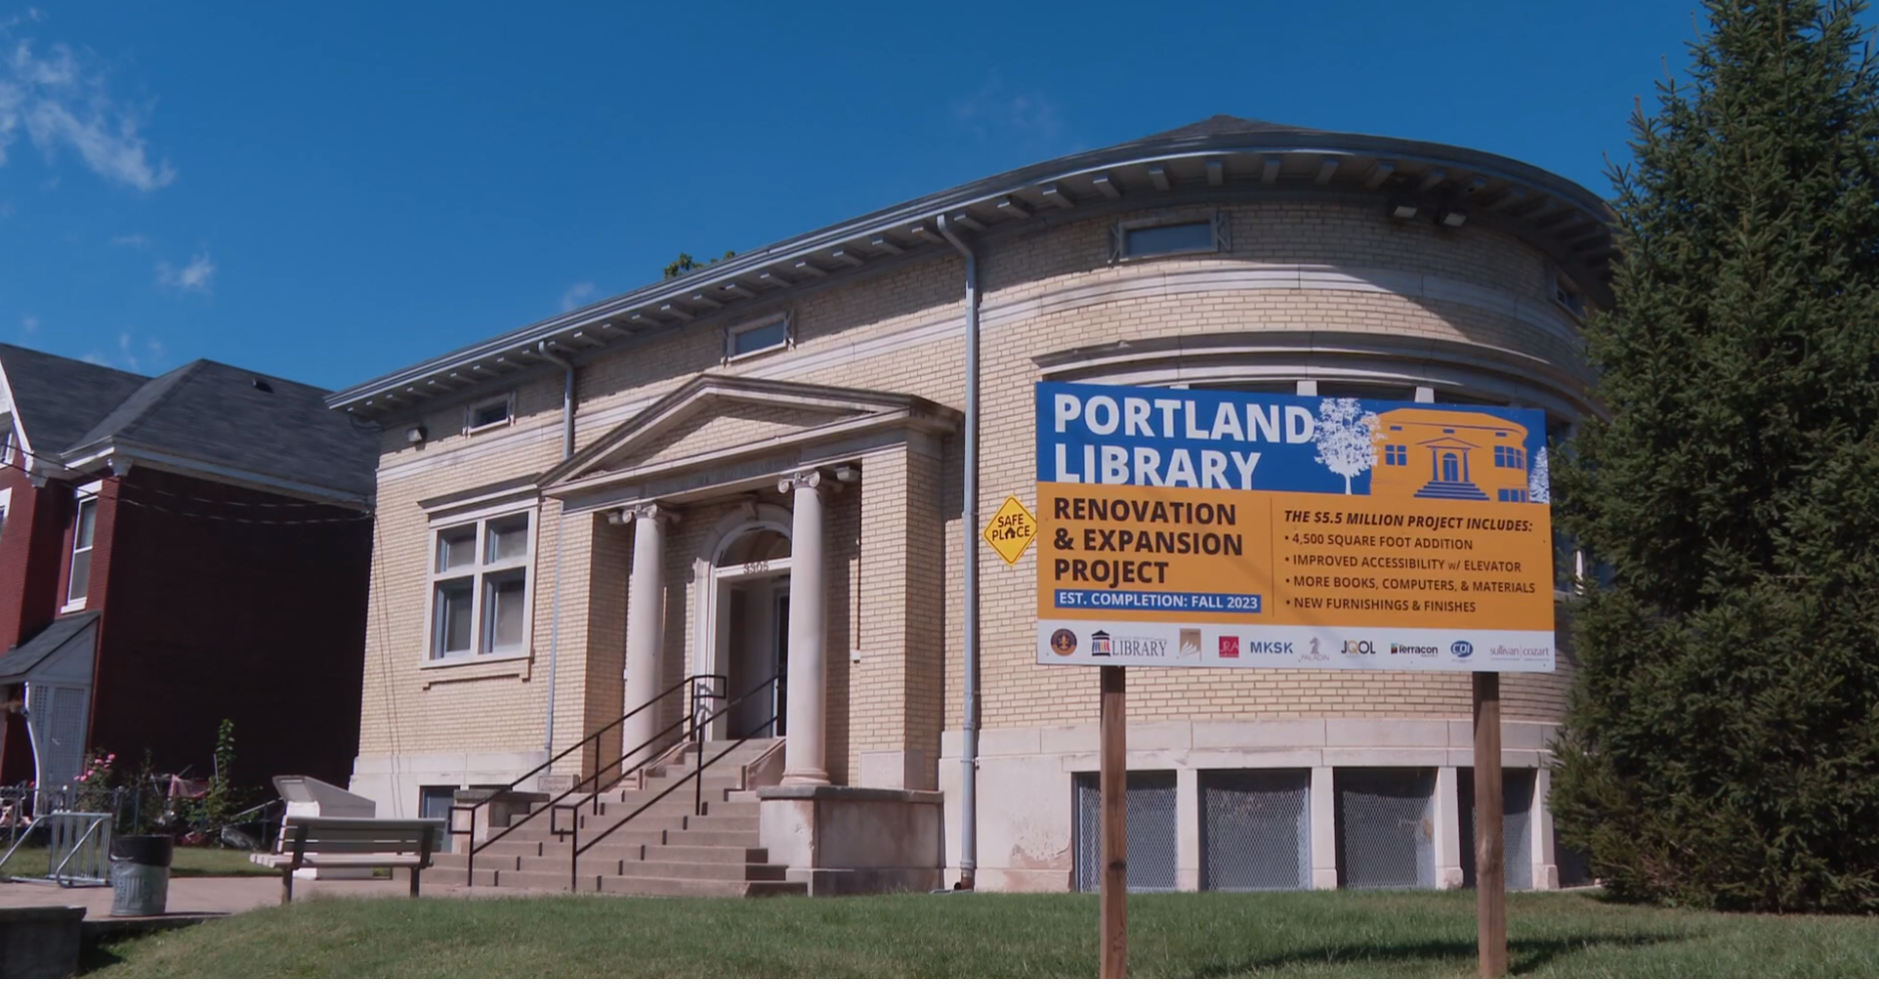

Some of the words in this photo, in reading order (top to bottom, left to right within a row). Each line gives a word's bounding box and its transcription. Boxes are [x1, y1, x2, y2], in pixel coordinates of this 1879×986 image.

[1054, 393, 1314, 444] PORTLAND
[1055, 443, 1262, 490] LIBRARY
[1054, 497, 1236, 525] RENOVATION
[997, 513, 1024, 528] SAFE
[1285, 510, 1310, 522] THE
[1314, 511, 1343, 524] $5.5
[1346, 513, 1404, 526] MILLION
[1407, 515, 1463, 531] PROJECT
[1467, 518, 1533, 532] INCLUDES:
[1054, 527, 1074, 550] &
[1083, 528, 1242, 556] EXPANSION
[1292, 533, 1324, 545] 4,500
[1327, 534, 1376, 547] SQUARE
[1380, 536, 1411, 548] FOOT
[1414, 538, 1473, 550] ADDITION
[1293, 554, 1358, 567] IMPROVED
[1361, 556, 1445, 570] ACCESSIBILITY
[1447, 560, 1460, 570] w/
[1464, 560, 1522, 572] ELEVATOR
[1055, 558, 1168, 588] PROJECT
[1294, 575, 1330, 587] MORE
[1333, 576, 1379, 590] BOOKS,
[1382, 578, 1457, 592] COMPUTERS,
[1460, 580, 1469, 592] &
[1473, 581, 1535, 593] MATERIALS
[1059, 592, 1087, 605] EST.
[1091, 592, 1188, 607] COMPLETION:
[1191, 595, 1223, 608] FALL
[1227, 596, 1258, 609] 2023
[1294, 597, 1323, 608] NEW
[1326, 598, 1409, 611] FURNISHINGS
[1412, 600, 1420, 611] &
[1424, 600, 1476, 613] FINISHES
[1112, 640, 1168, 657] LIBRARY
[1250, 641, 1294, 655] MKSK
[1341, 640, 1376, 655] JQOL
[1301, 654, 1330, 662] PALADIN
